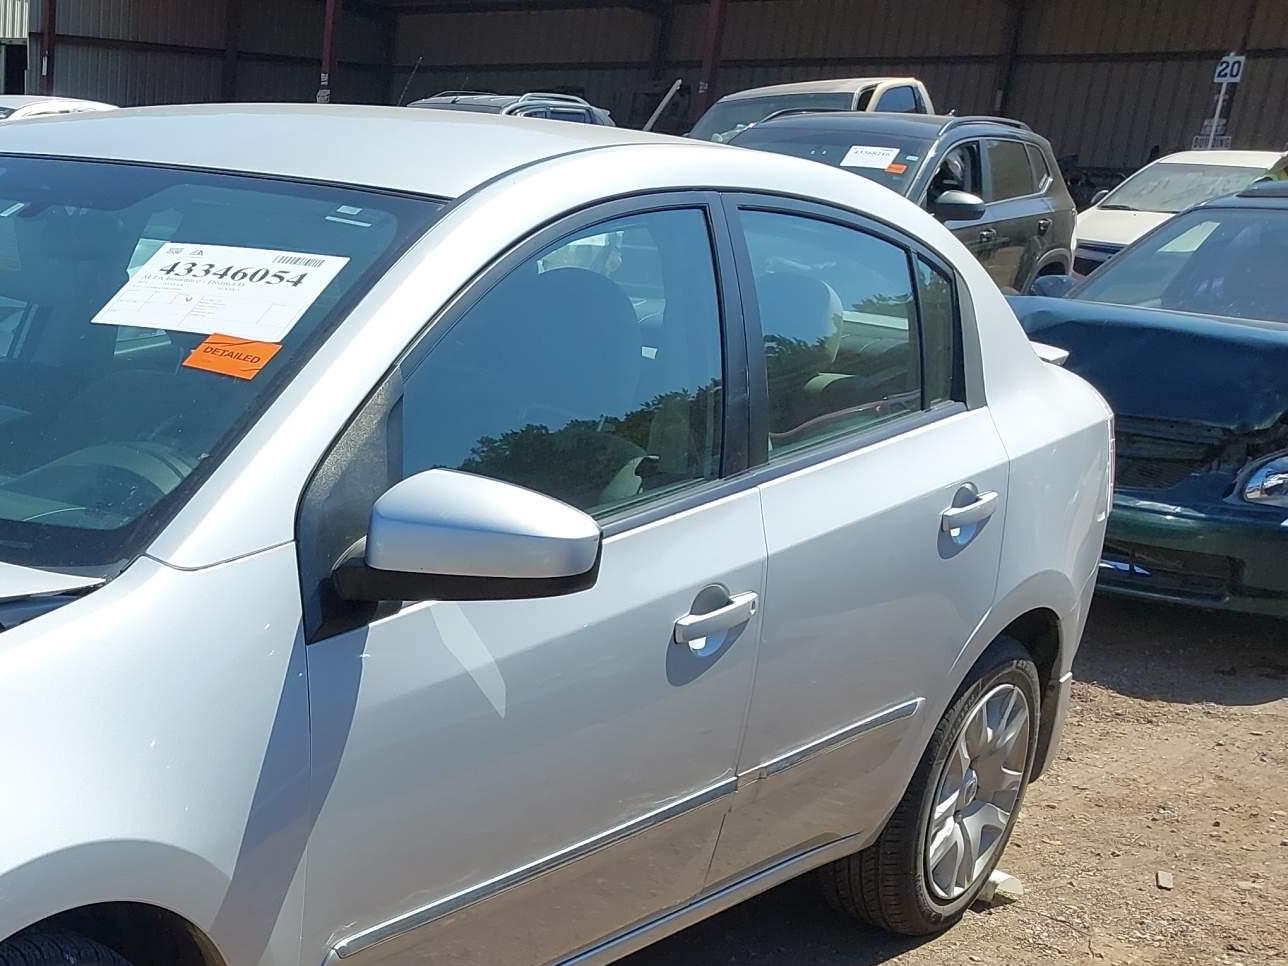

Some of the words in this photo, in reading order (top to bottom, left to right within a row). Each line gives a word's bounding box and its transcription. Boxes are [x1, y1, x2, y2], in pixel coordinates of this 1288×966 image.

[1216, 60, 1242, 78] 20
[159, 261, 308, 287] 43346054
[203, 346, 261, 364] DETAILED
